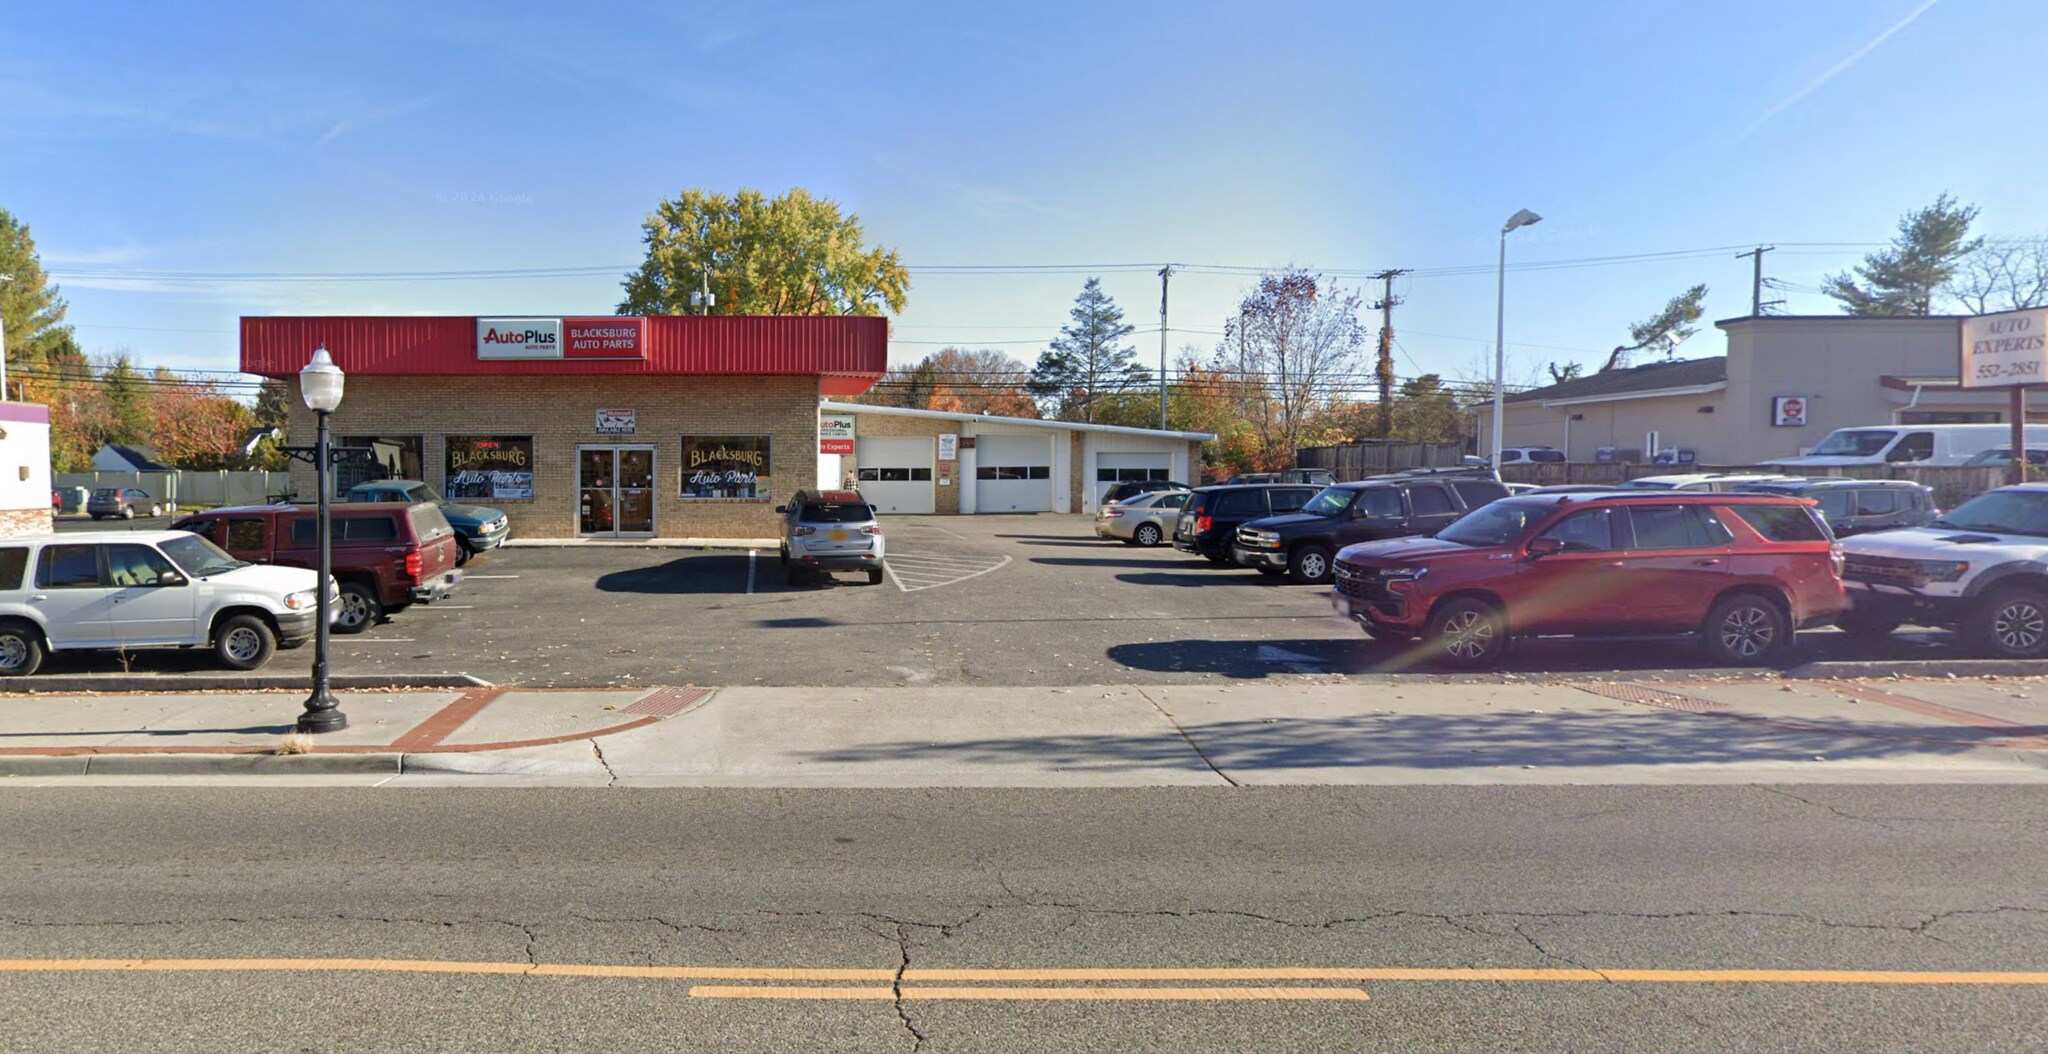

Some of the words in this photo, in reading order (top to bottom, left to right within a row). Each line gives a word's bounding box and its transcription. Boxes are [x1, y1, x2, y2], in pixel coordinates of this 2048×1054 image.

[571, 328, 636, 338] BLACKSBURG
[1985, 317, 2031, 335] AUTO
[483, 328, 556, 344] AutoPlus
[573, 339, 600, 349] AUTO
[603, 339, 634, 349] PARTS
[1973, 334, 2046, 355] EXPERTS
[1976, 360, 2040, 379] 552-2851
[452, 449, 526, 468] BLACKSBURG
[691, 449, 762, 467] BLACKSBURG
[453, 469, 485, 485] Auto
[488, 470, 522, 485] Parts
[690, 470, 721, 485] Auto
[724, 470, 758, 484] Parts
